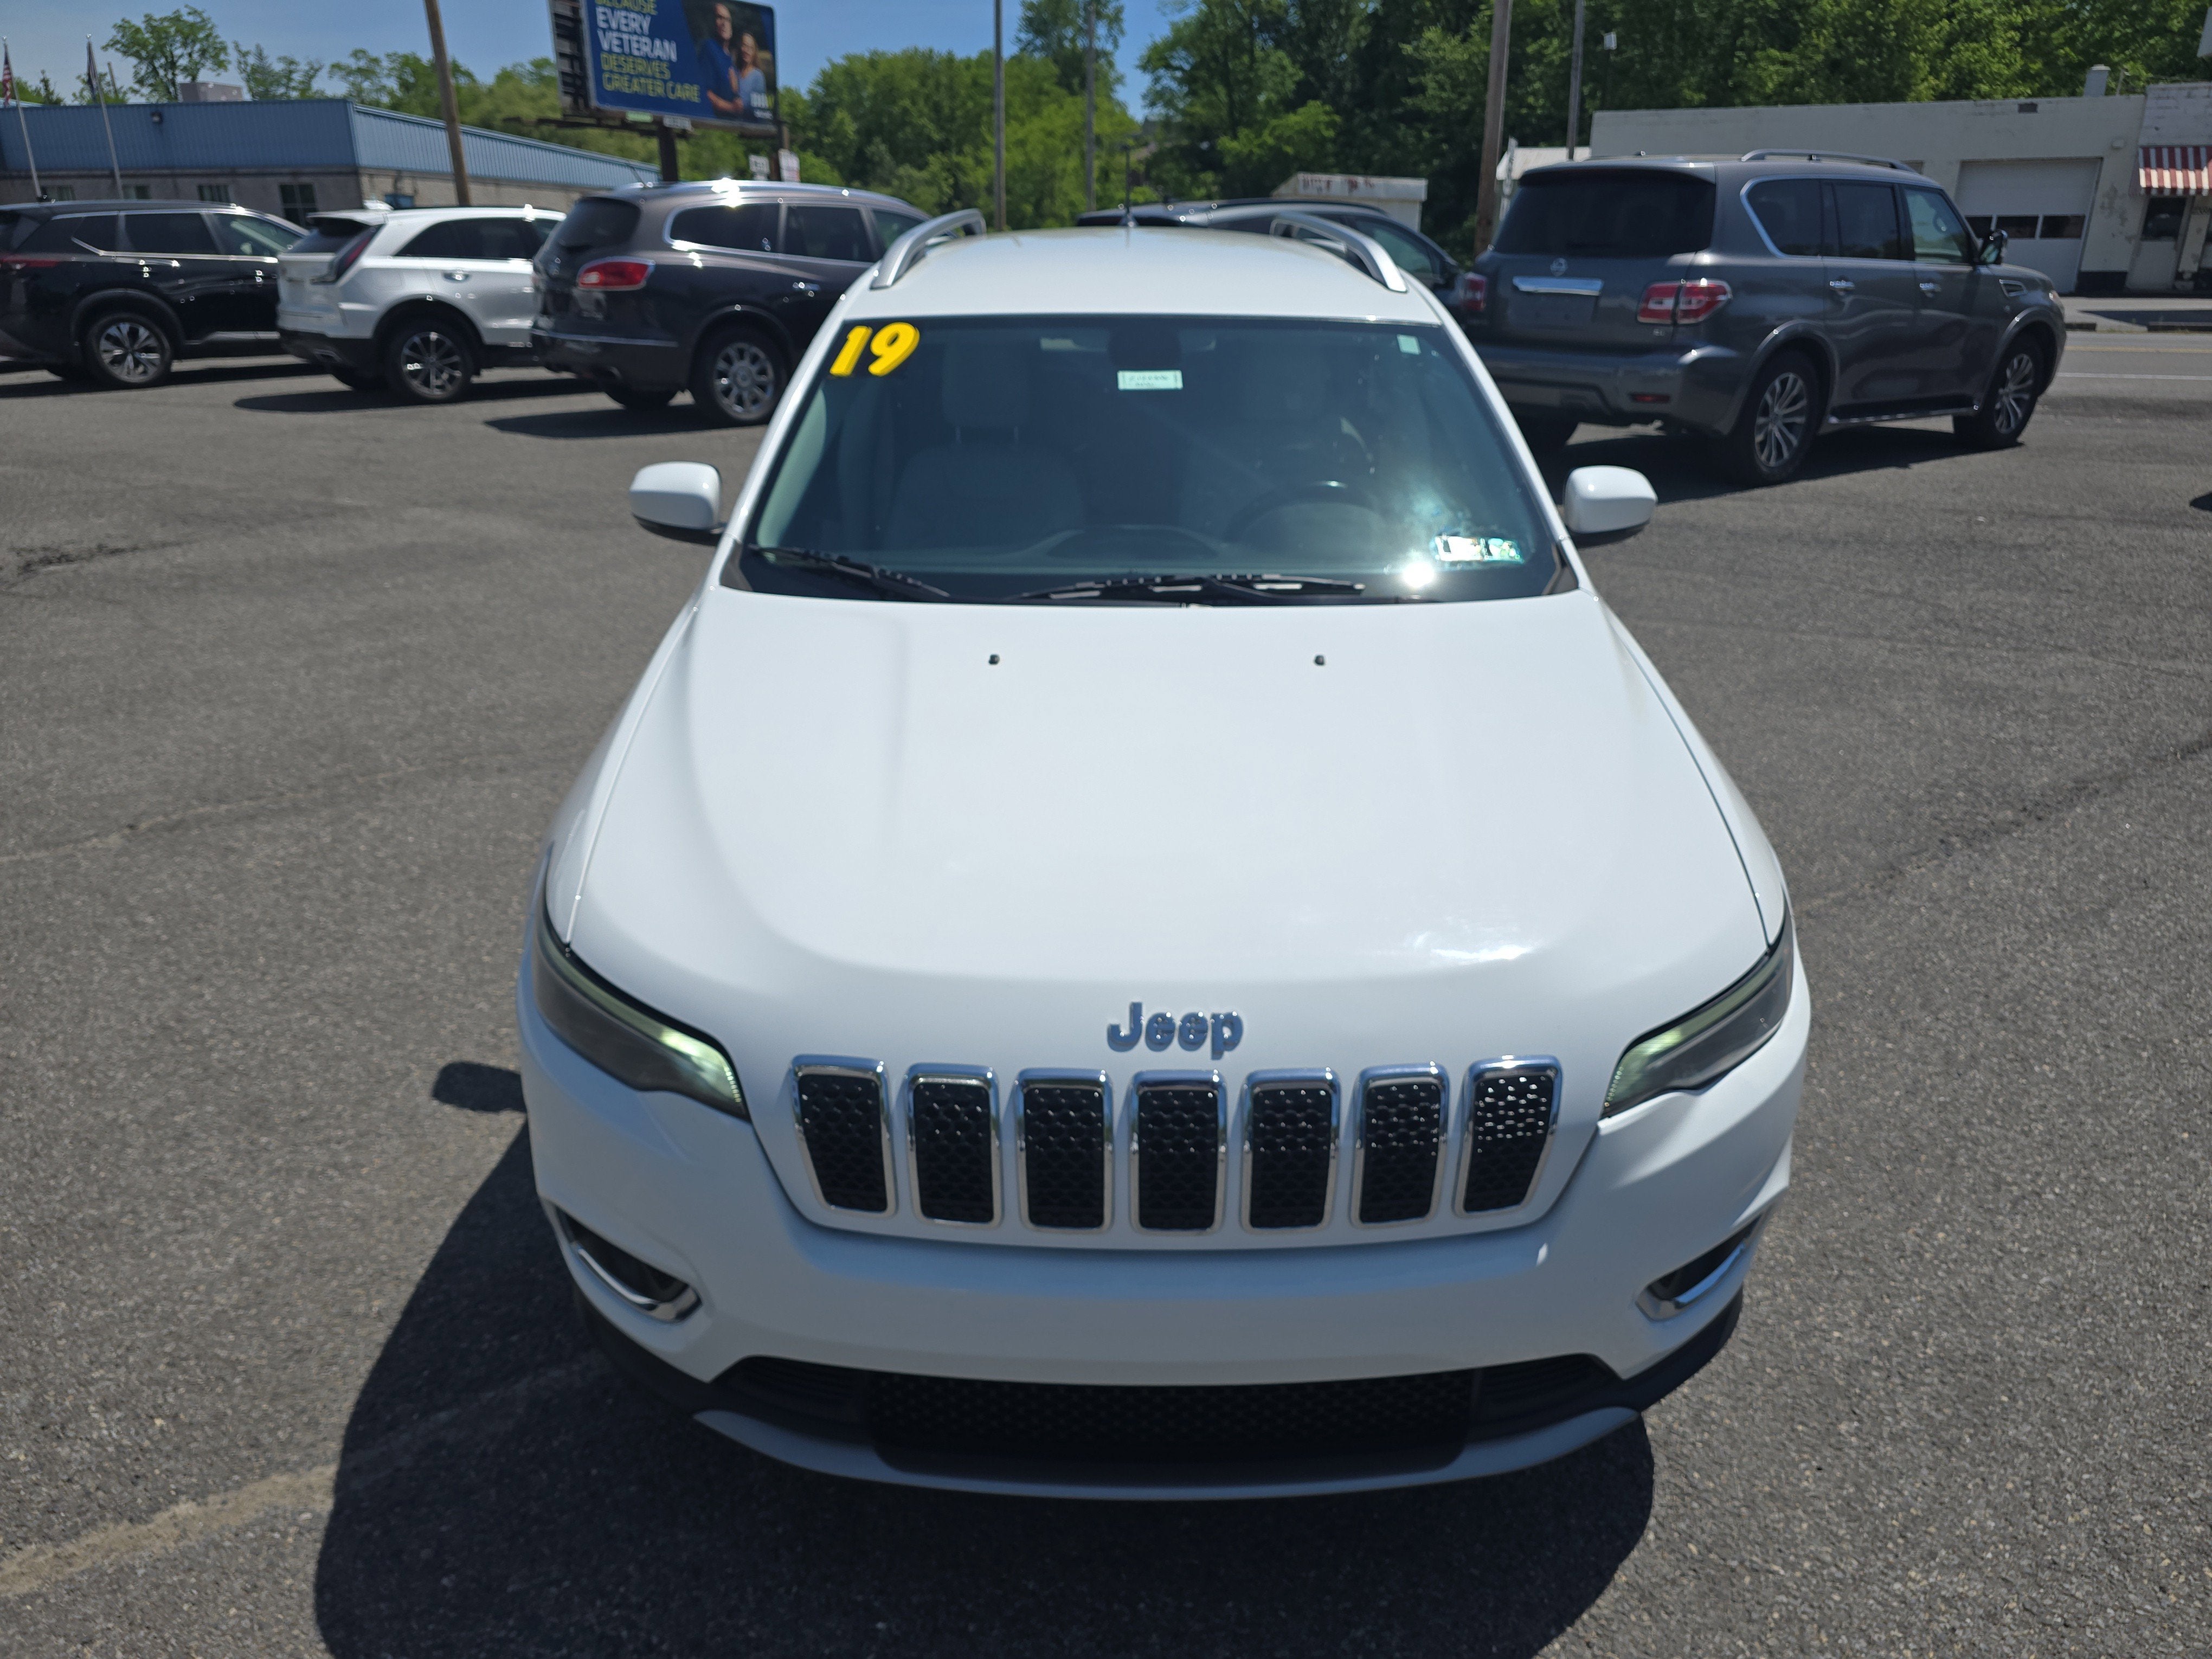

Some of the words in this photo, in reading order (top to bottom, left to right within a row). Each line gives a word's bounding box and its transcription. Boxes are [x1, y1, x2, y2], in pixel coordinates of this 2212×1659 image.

[596, 7, 651, 35] EVERY
[597, 29, 677, 62] VETERAN
[601, 53, 670, 80] DESERVES
[603, 73, 665, 98] GREATER
[667, 82, 700, 103] CARE
[829, 322, 920, 377] 19
[1107, 1001, 1244, 1060] Jeep
